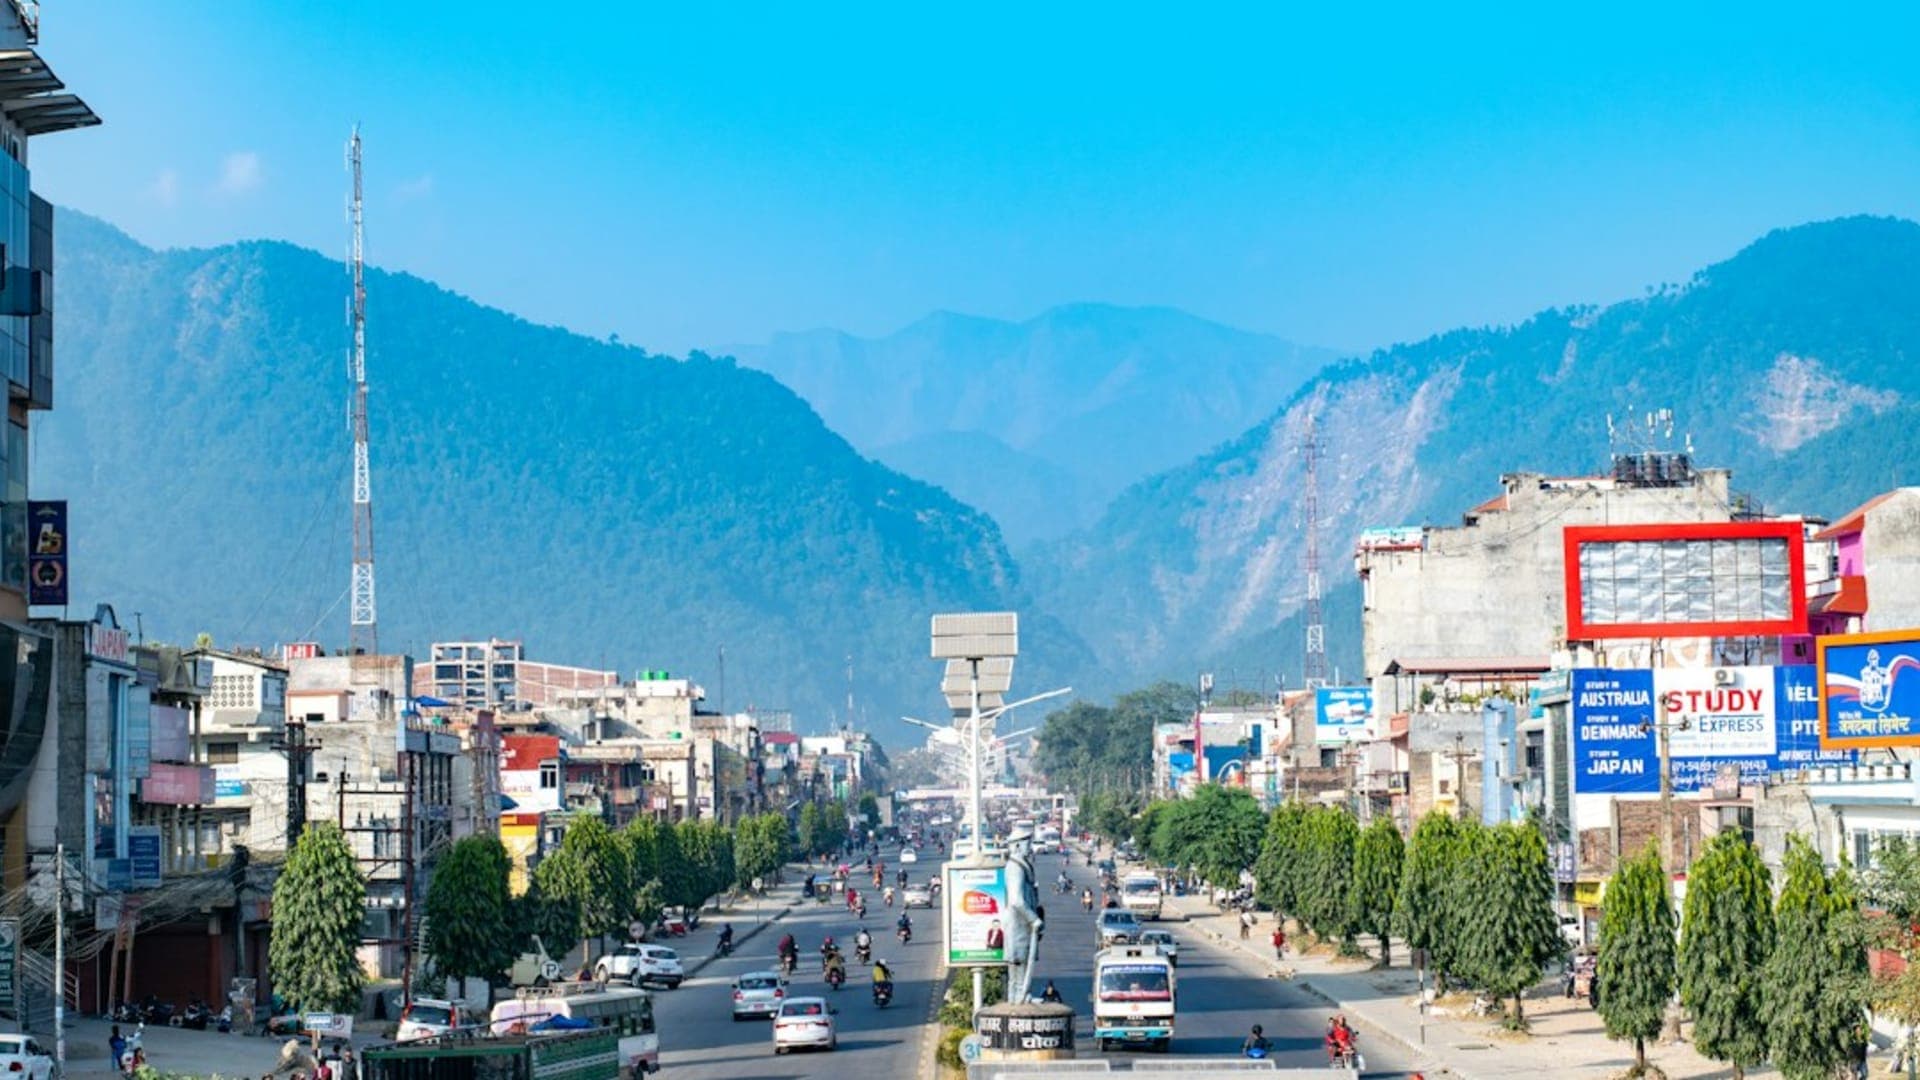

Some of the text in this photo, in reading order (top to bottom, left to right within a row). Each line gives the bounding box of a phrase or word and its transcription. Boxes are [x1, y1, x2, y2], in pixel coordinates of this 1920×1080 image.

[1580, 690, 1650, 707] AUSTRALIA
[1666, 689, 1763, 713] STUDY
[1581, 723, 1647, 741] DENMARK
[1699, 715, 1764, 733] EXPRESS
[1587, 758, 1644, 775] JAPAN
[546, 964, 556, 976] P
